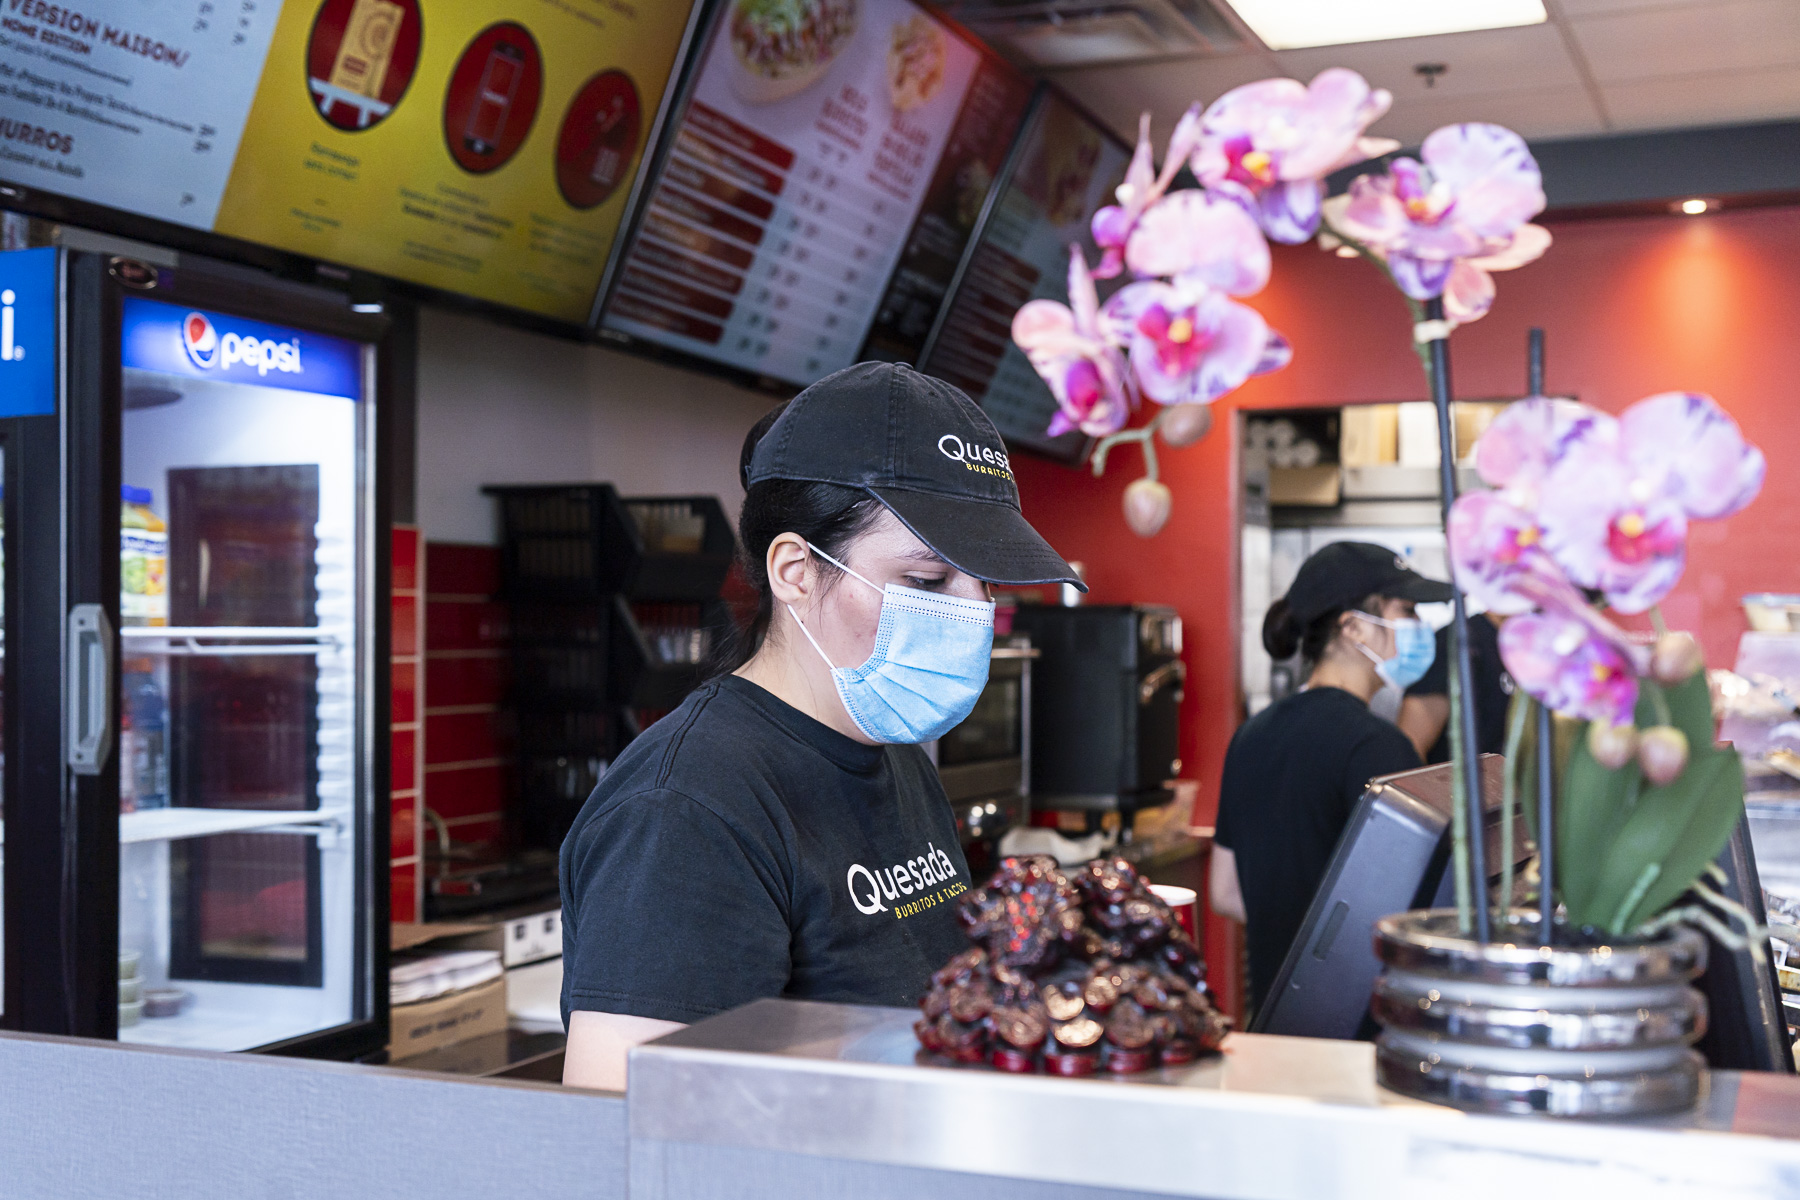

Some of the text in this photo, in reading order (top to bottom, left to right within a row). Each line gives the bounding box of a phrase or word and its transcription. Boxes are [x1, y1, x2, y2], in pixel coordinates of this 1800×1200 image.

[221, 331, 301, 377] pepsi
[846, 841, 958, 915] Quesada
[894, 881, 968, 919] BURRITOS & TACOS
